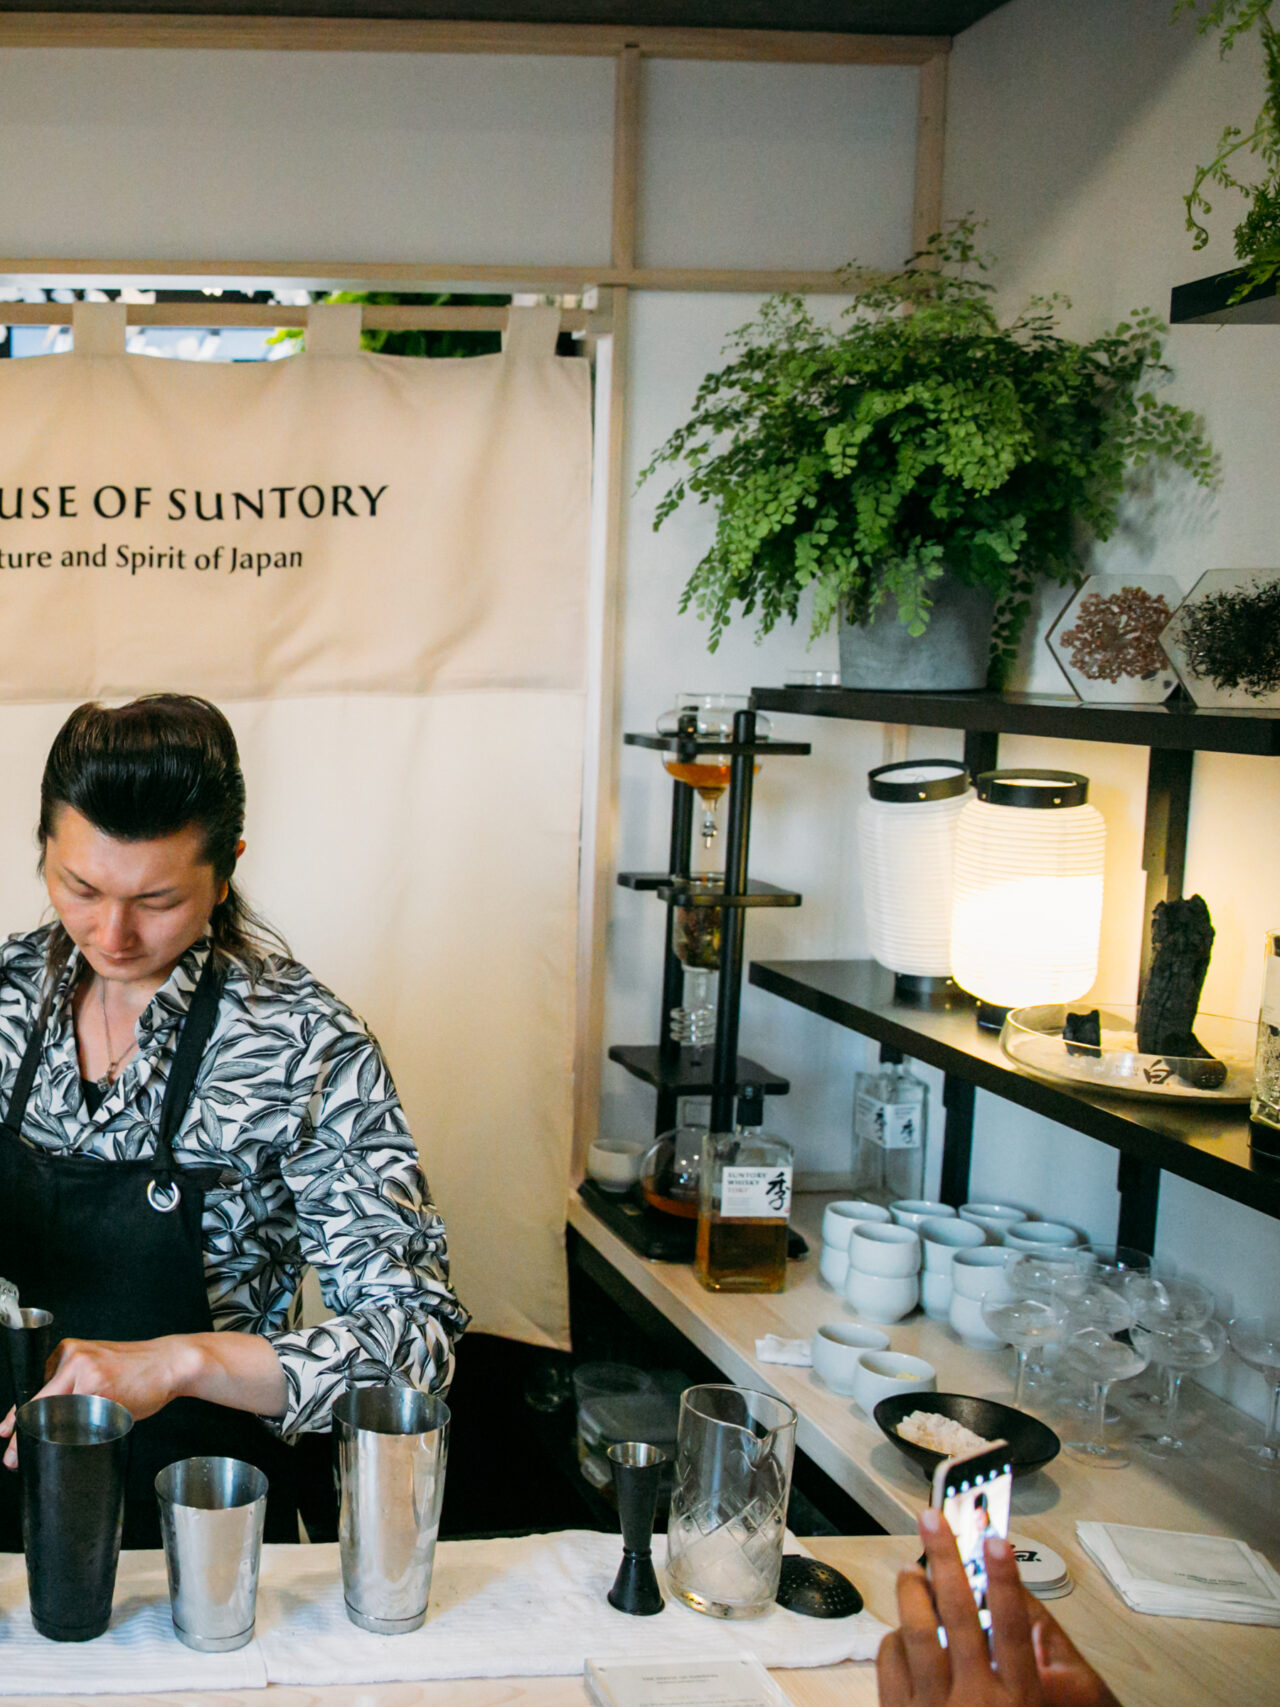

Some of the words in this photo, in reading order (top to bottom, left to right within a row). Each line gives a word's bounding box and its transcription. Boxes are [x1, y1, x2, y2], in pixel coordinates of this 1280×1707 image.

[92, 485, 154, 520] OF
[168, 484, 388, 523] SUNTORY
[60, 542, 108, 569] and
[116, 544, 186, 577] Spirit
[193, 545, 225, 571] of
[227, 546, 304, 578] Japan
